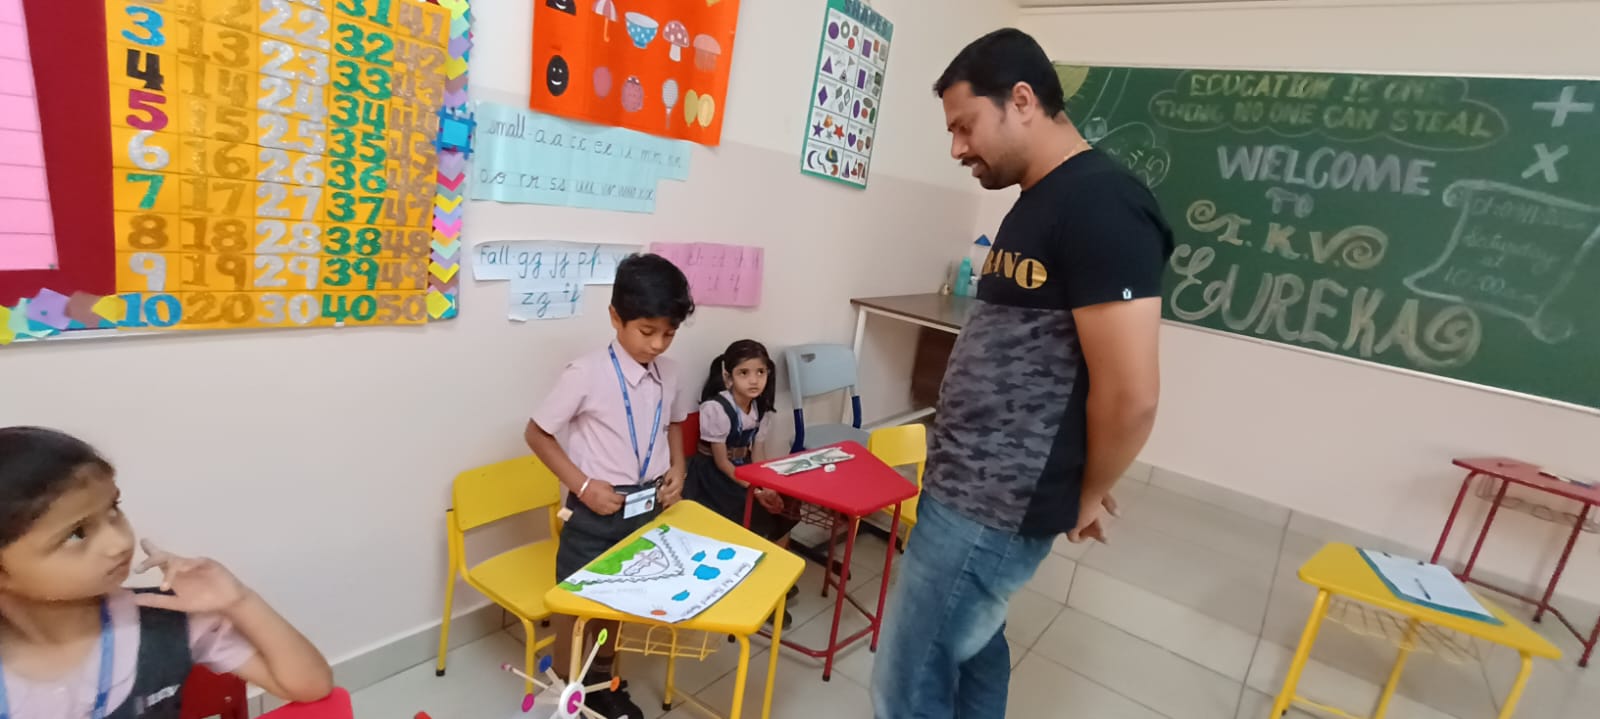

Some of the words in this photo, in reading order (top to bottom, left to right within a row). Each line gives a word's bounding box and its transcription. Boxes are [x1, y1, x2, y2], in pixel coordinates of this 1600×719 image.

[259, 0, 330, 50] 22
[335, 23, 394, 67] 32
[395, 40, 446, 79] 42
[399, 3, 444, 42] 41
[121, 6, 166, 47] 3
[177, 19, 249, 67] 13
[260, 40, 330, 86] 23
[333, 60, 392, 100] 33
[391, 72, 445, 112] 43
[126, 48, 164, 91] 4
[177, 60, 249, 107] 14
[257, 77, 328, 121] 24
[330, 94, 387, 135] 34
[126, 89, 168, 131] 5
[187, 102, 249, 143] 15
[257, 113, 327, 155] 25
[328, 127, 387, 165] 35
[1233, 102, 1264, 122] NO
[1270, 104, 1317, 124] ONE
[1323, 105, 1379, 130] CAN
[1390, 108, 1492, 137] STEAL
[128, 130, 170, 171] 6
[183, 140, 250, 178] 16
[256, 148, 326, 187] 26
[327, 159, 387, 194] 36
[1217, 145, 1436, 196] WELCOME
[126, 173, 165, 209] 7
[180, 176, 247, 216] 17
[256, 183, 322, 221] 27
[326, 191, 385, 225] 37
[385, 194, 433, 229] 47
[1264, 187, 1314, 218] TO
[128, 214, 169, 250] 8
[181, 217, 248, 252] 18
[254, 220, 321, 254] 28
[323, 226, 382, 257] 38
[382, 229, 430, 259] 48
[129, 252, 166, 292] 9
[182, 252, 247, 292] 19
[253, 254, 320, 290] 29
[322, 257, 379, 290] 39
[380, 260, 427, 291] 49
[116, 292, 183, 327] 10
[181, 291, 255, 324] 20
[256, 293, 320, 325] 30
[320, 294, 378, 323] 40
[376, 294, 426, 321] 50
